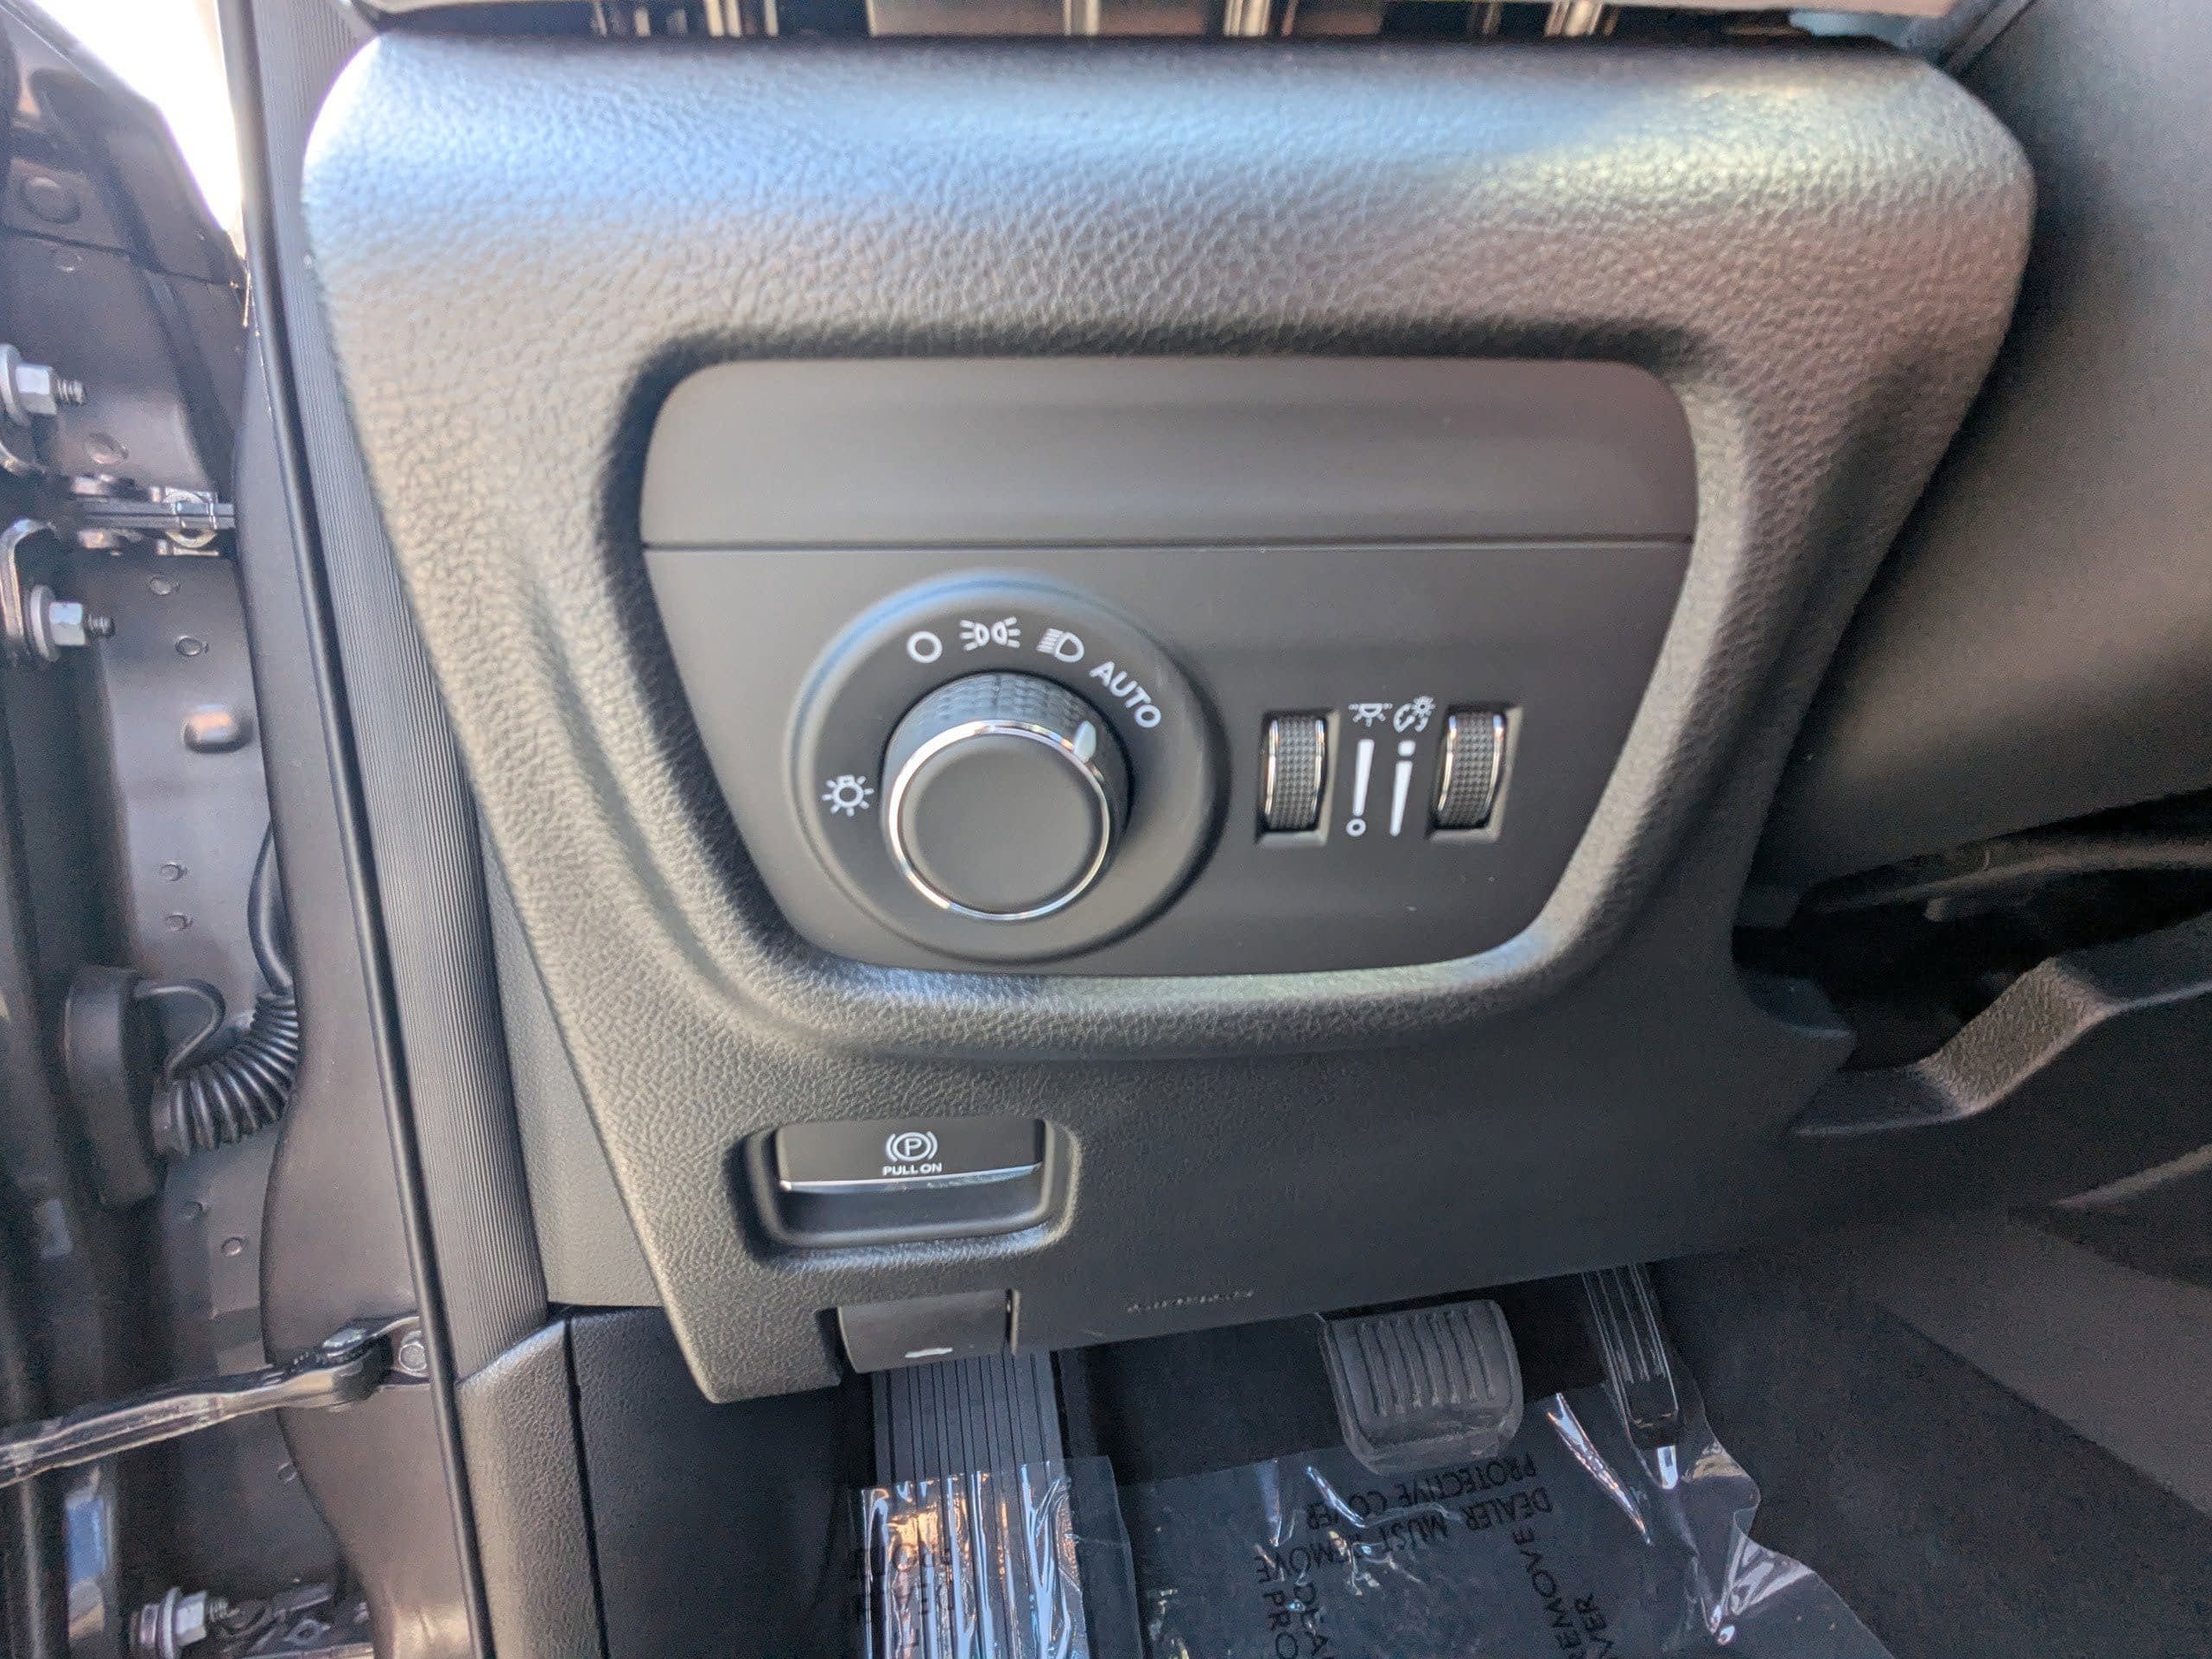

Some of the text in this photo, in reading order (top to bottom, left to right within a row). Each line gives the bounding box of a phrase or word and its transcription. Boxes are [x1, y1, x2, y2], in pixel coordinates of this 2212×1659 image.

[1090, 660, 1161, 729] AUTO
[882, 1162, 943, 1176] PULL ON
[1306, 1452, 1536, 1530] PROTECTIVE COER
[1254, 1486, 1554, 1583] DEALER MUST MOVE
[1294, 1581, 1336, 1658] DEA
